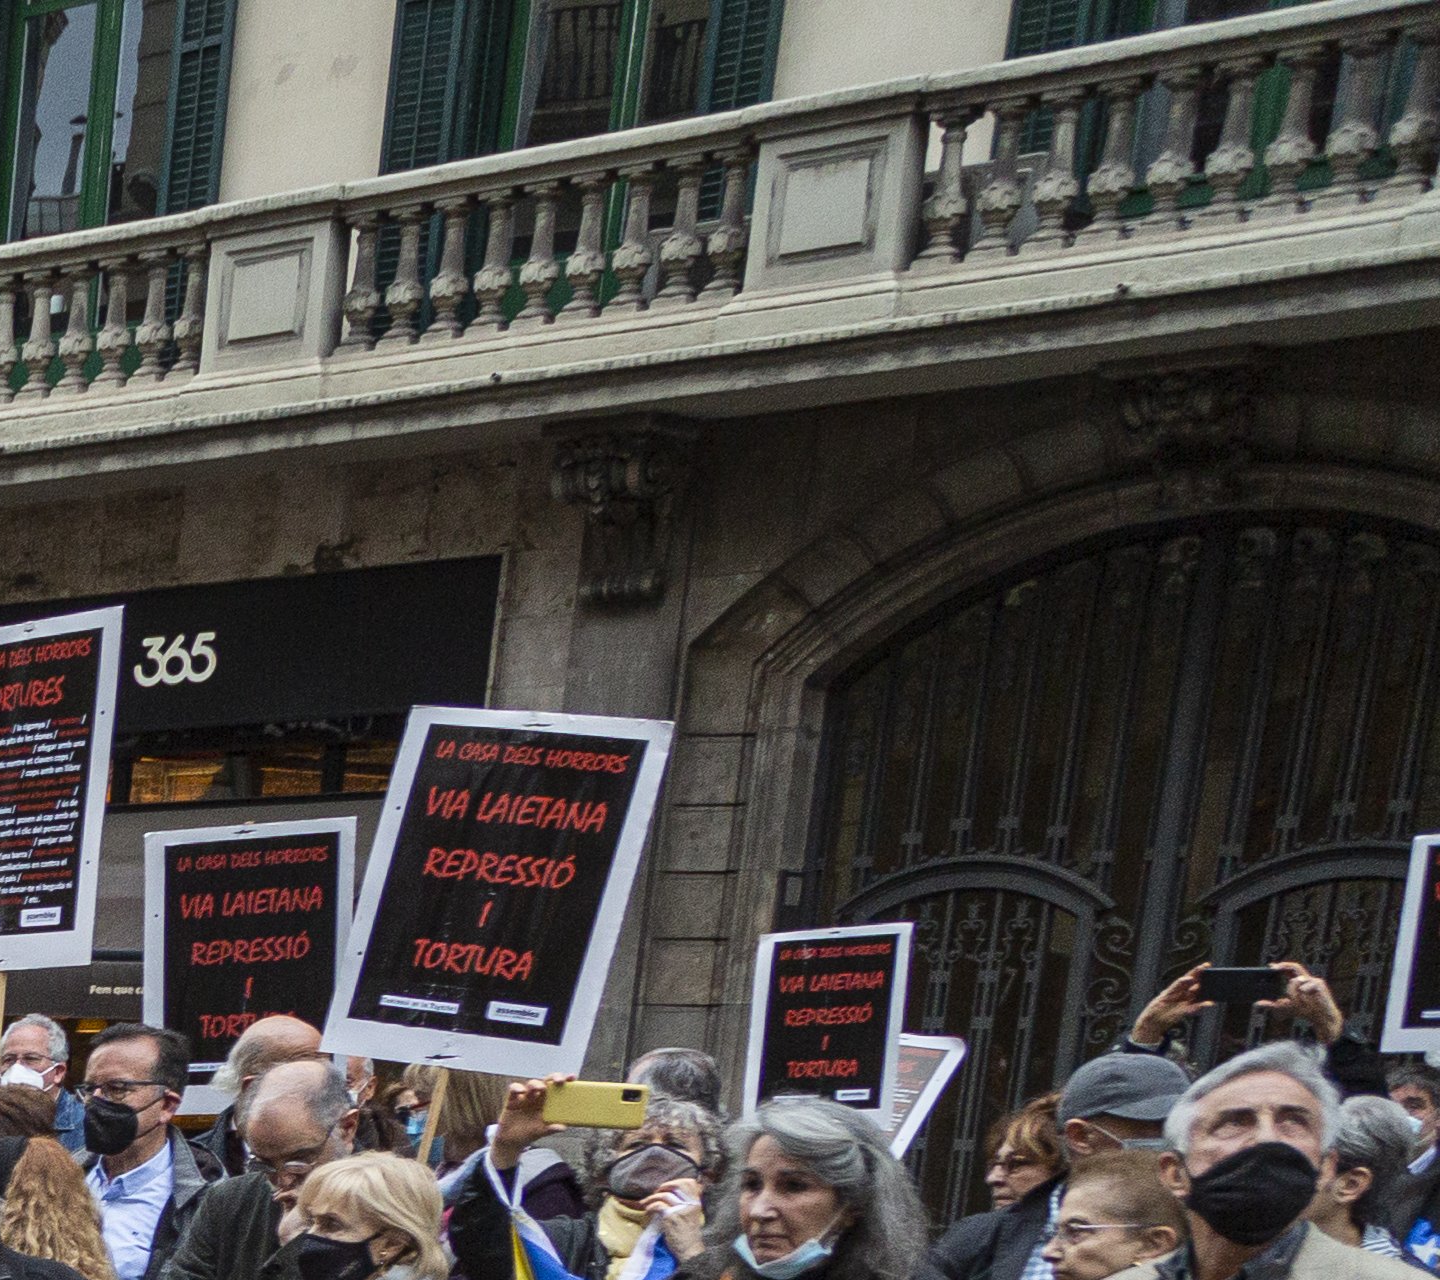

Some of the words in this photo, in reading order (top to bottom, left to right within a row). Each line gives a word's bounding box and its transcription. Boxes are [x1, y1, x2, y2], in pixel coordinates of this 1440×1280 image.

[9, 647, 32, 667] DELS
[35, 637, 93, 663] HORRORS
[133, 632, 217, 687] 365
[435, 740, 455, 759] LA
[459, 742, 500, 761] CASA
[502, 745, 544, 766] DELS
[544, 749, 630, 774] HORRORS
[426, 785, 471, 820] VIA
[476, 791, 608, 833] LAIETANA
[177, 857, 192, 873] LA
[195, 854, 226, 870] CASA
[230, 851, 261, 869] DELS
[265, 846, 329, 866] HORRORS
[422, 847, 577, 889] REPRESSIÓ
[180, 893, 214, 920] VIA
[222, 885, 324, 917] LAIETANA
[477, 900, 494, 929] I
[191, 930, 311, 966] REPRESSIÓ
[412, 937, 533, 981] TORTURA
[90, 985, 112, 995] Fem
[114, 988, 135, 997] que
[244, 976, 255, 999] I
[780, 974, 805, 994] VIA
[809, 970, 885, 993] LAIETANA
[785, 1001, 873, 1027] REPRESSIÓ
[821, 1034, 829, 1051] I
[787, 1059, 860, 1079] TORTURA
